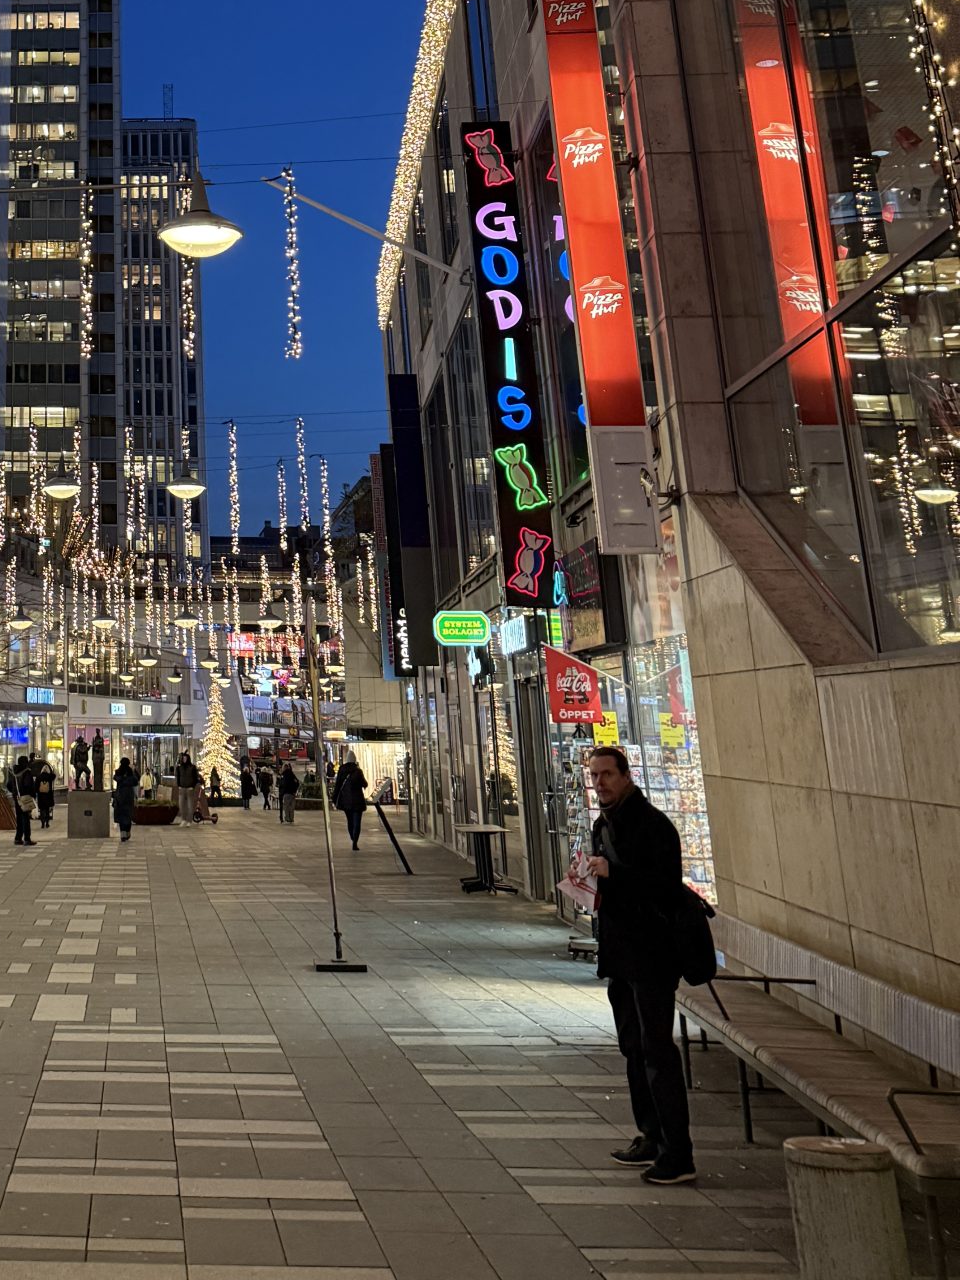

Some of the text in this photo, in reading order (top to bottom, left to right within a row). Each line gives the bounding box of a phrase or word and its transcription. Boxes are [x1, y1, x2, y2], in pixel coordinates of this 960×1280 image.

[548, 1, 587, 18] Pizza
[556, 10, 584, 25] Hut
[564, 141, 605, 160] Pizza
[572, 151, 603, 168] Hut
[582, 290, 623, 310] Pizza
[475, 201, 533, 431] GODIS
[590, 302, 621, 319] Hut
[559, 708, 595, 719] ÖPPET
